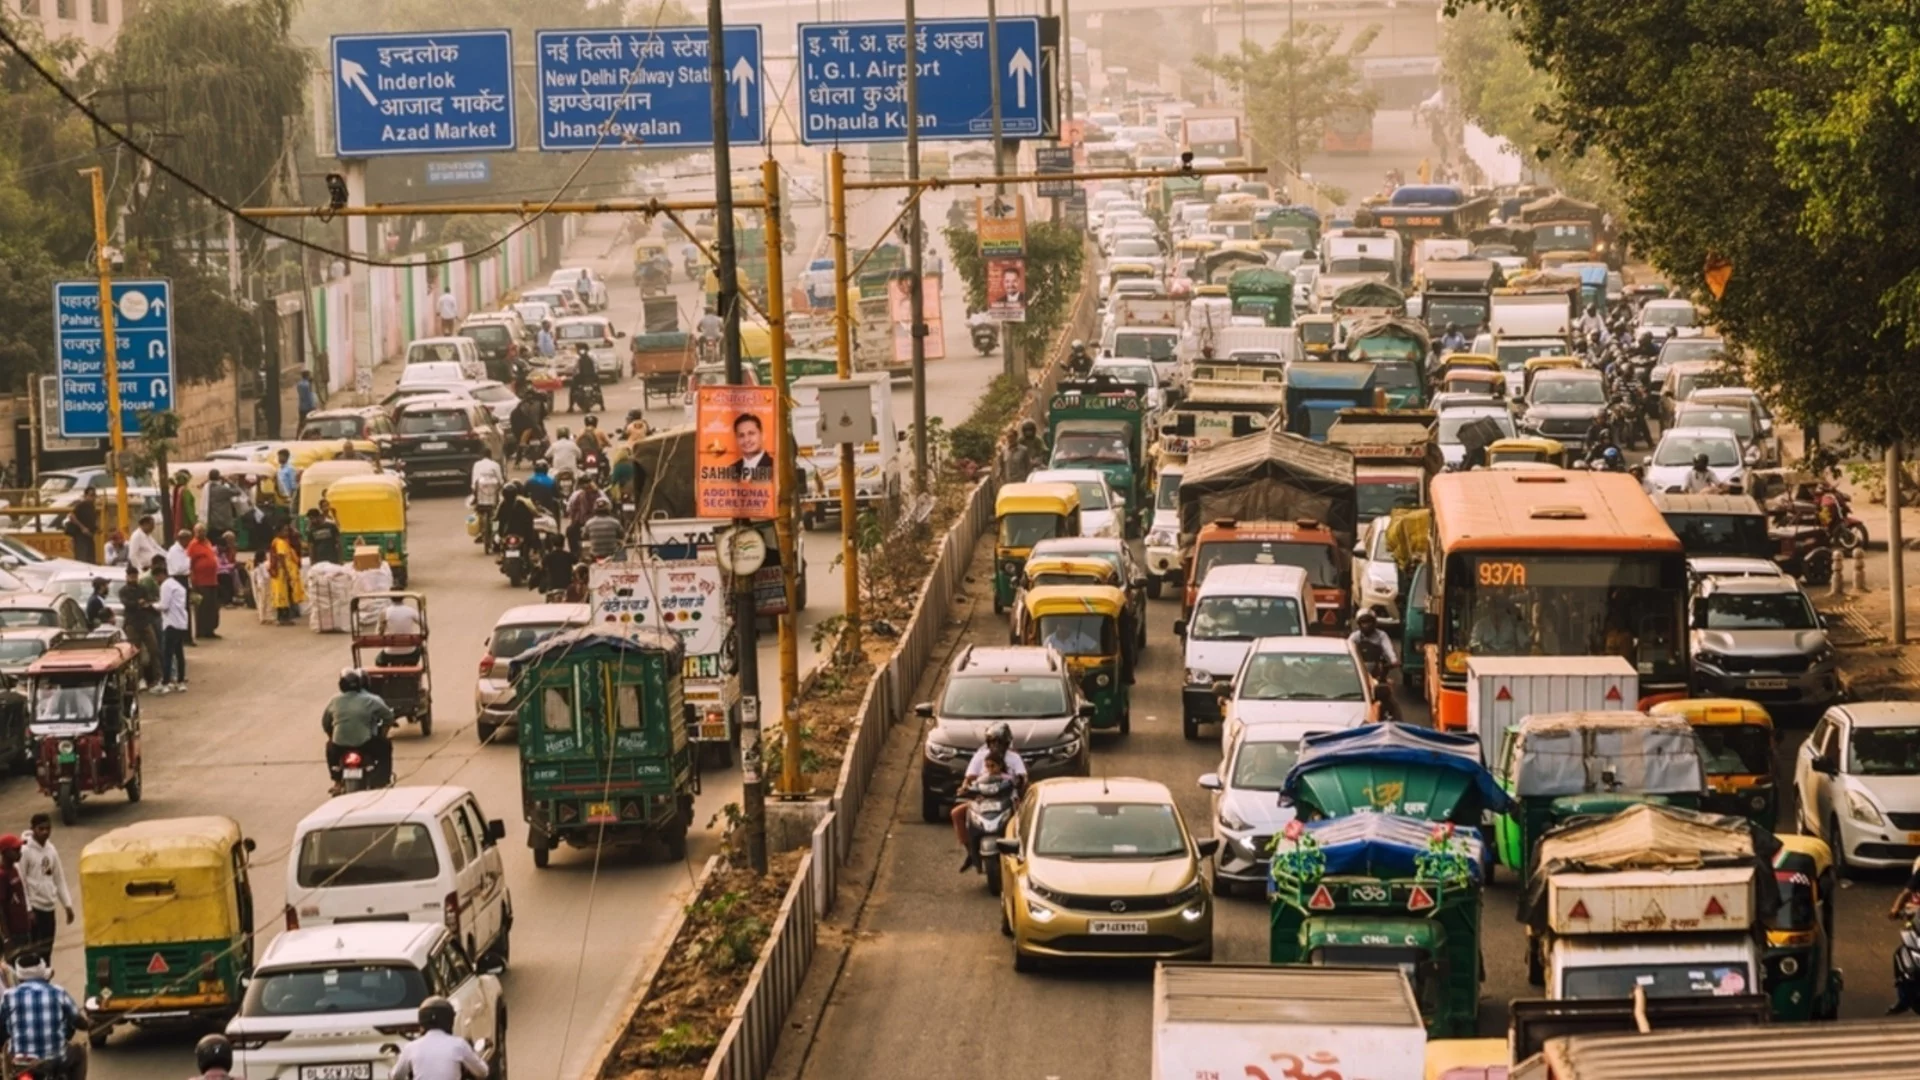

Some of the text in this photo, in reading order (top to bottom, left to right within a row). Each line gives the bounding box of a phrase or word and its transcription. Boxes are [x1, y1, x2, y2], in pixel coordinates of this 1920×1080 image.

[377, 40, 459, 68] इन्द्रलोक
[545, 37, 569, 63] नई
[576, 35, 622, 61] दिल्ली
[629, 35, 665, 59] रेलवे
[546, 70, 577, 87] New
[581, 68, 617, 86] Delhi
[678, 66, 730, 84] Statin
[824, 62, 845, 79] G.
[378, 72, 456, 90] Inderlok
[380, 89, 505, 116] आजाद मार्केट
[809, 81, 856, 106] धौला
[381, 121, 497, 141] Azad Market
[809, 113, 879, 131] Dhaula
[63, 360, 100, 373] Rajpur
[703, 499, 768, 508] SECRETARY
[1479, 562, 1526, 585] 937A
